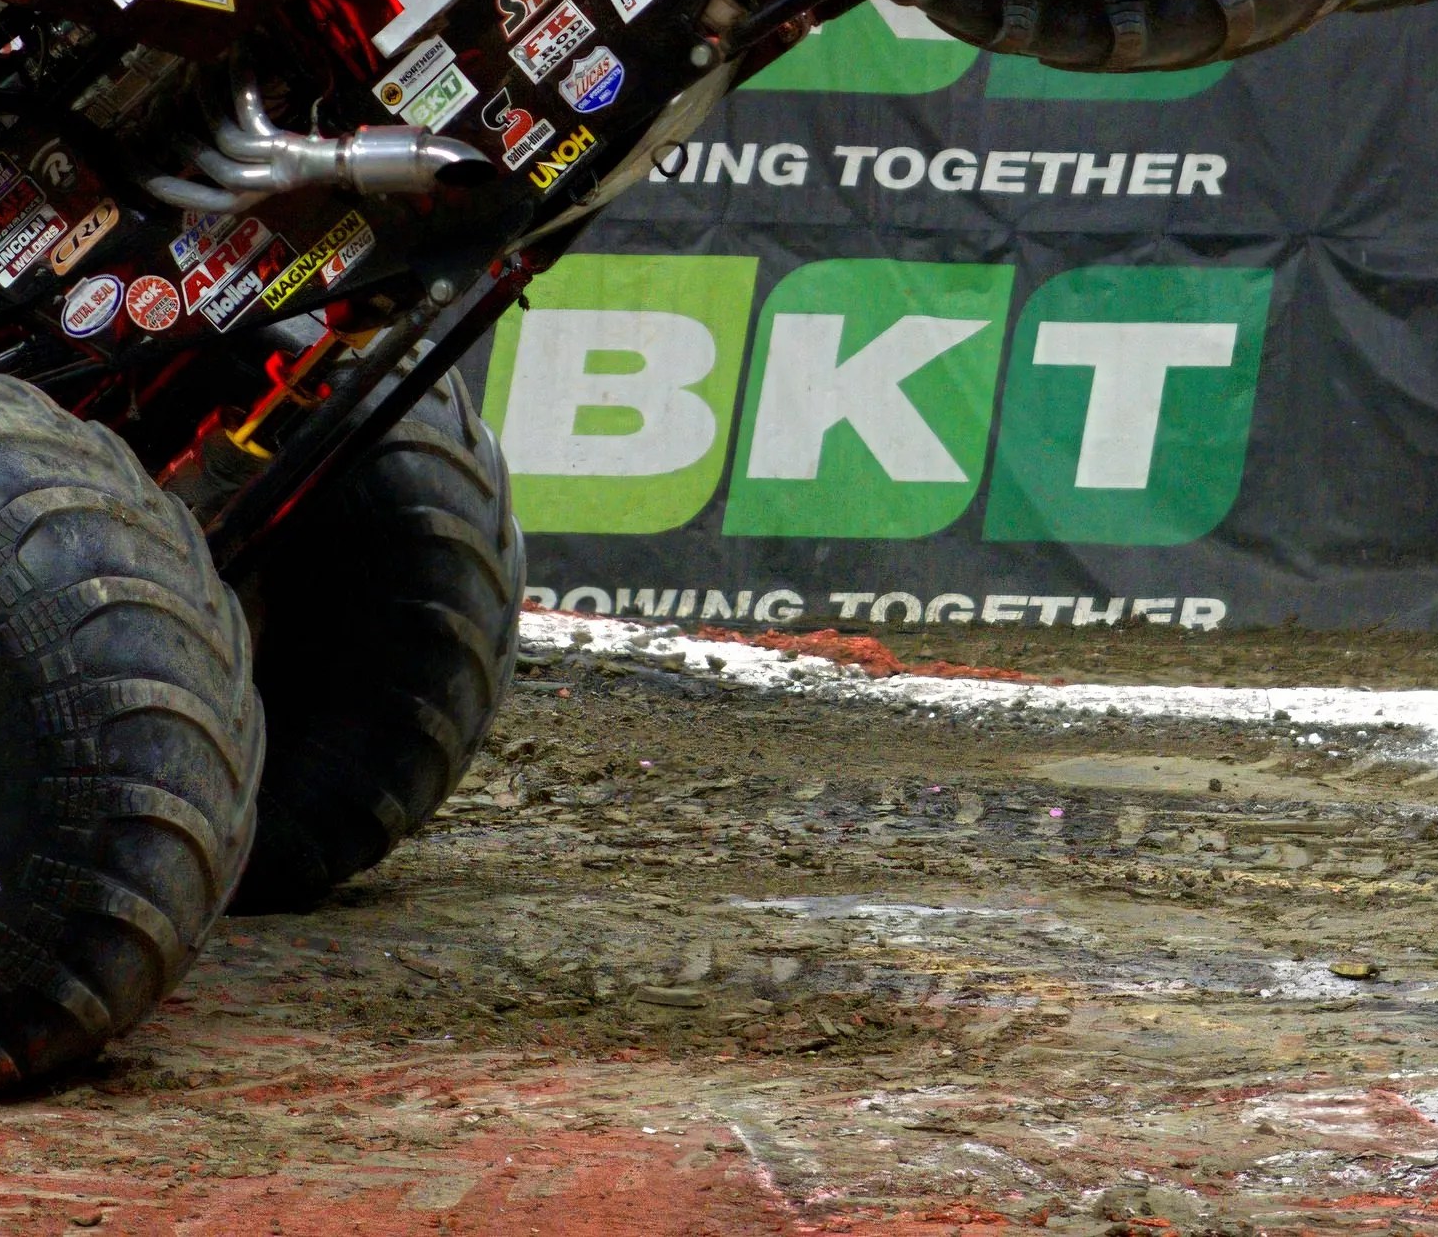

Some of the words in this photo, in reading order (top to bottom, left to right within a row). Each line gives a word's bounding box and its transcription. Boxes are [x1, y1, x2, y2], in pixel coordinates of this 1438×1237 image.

[524, 6, 577, 59] FK
[534, 25, 590, 79] ENDS
[539, 20, 583, 60] ROD
[399, 42, 444, 85] NORTHERN
[575, 57, 610, 100] LUCAS
[529, 124, 596, 189] UNOH
[833, 145, 1227, 196] TOGETHER
[12, 224, 60, 272] WELDERS
[184, 218, 260, 312] ARP
[265, 214, 361, 307] MAGNAFLOW
[342, 233, 373, 264] KING
[68, 302, 96, 328] TOTAL
[90, 282, 115, 306] SEAL
[131, 282, 163, 313] NGK
[203, 270, 264, 326] Holley
[498, 308, 1237, 489] BKT
[829, 591, 1227, 632] TOGETHER
